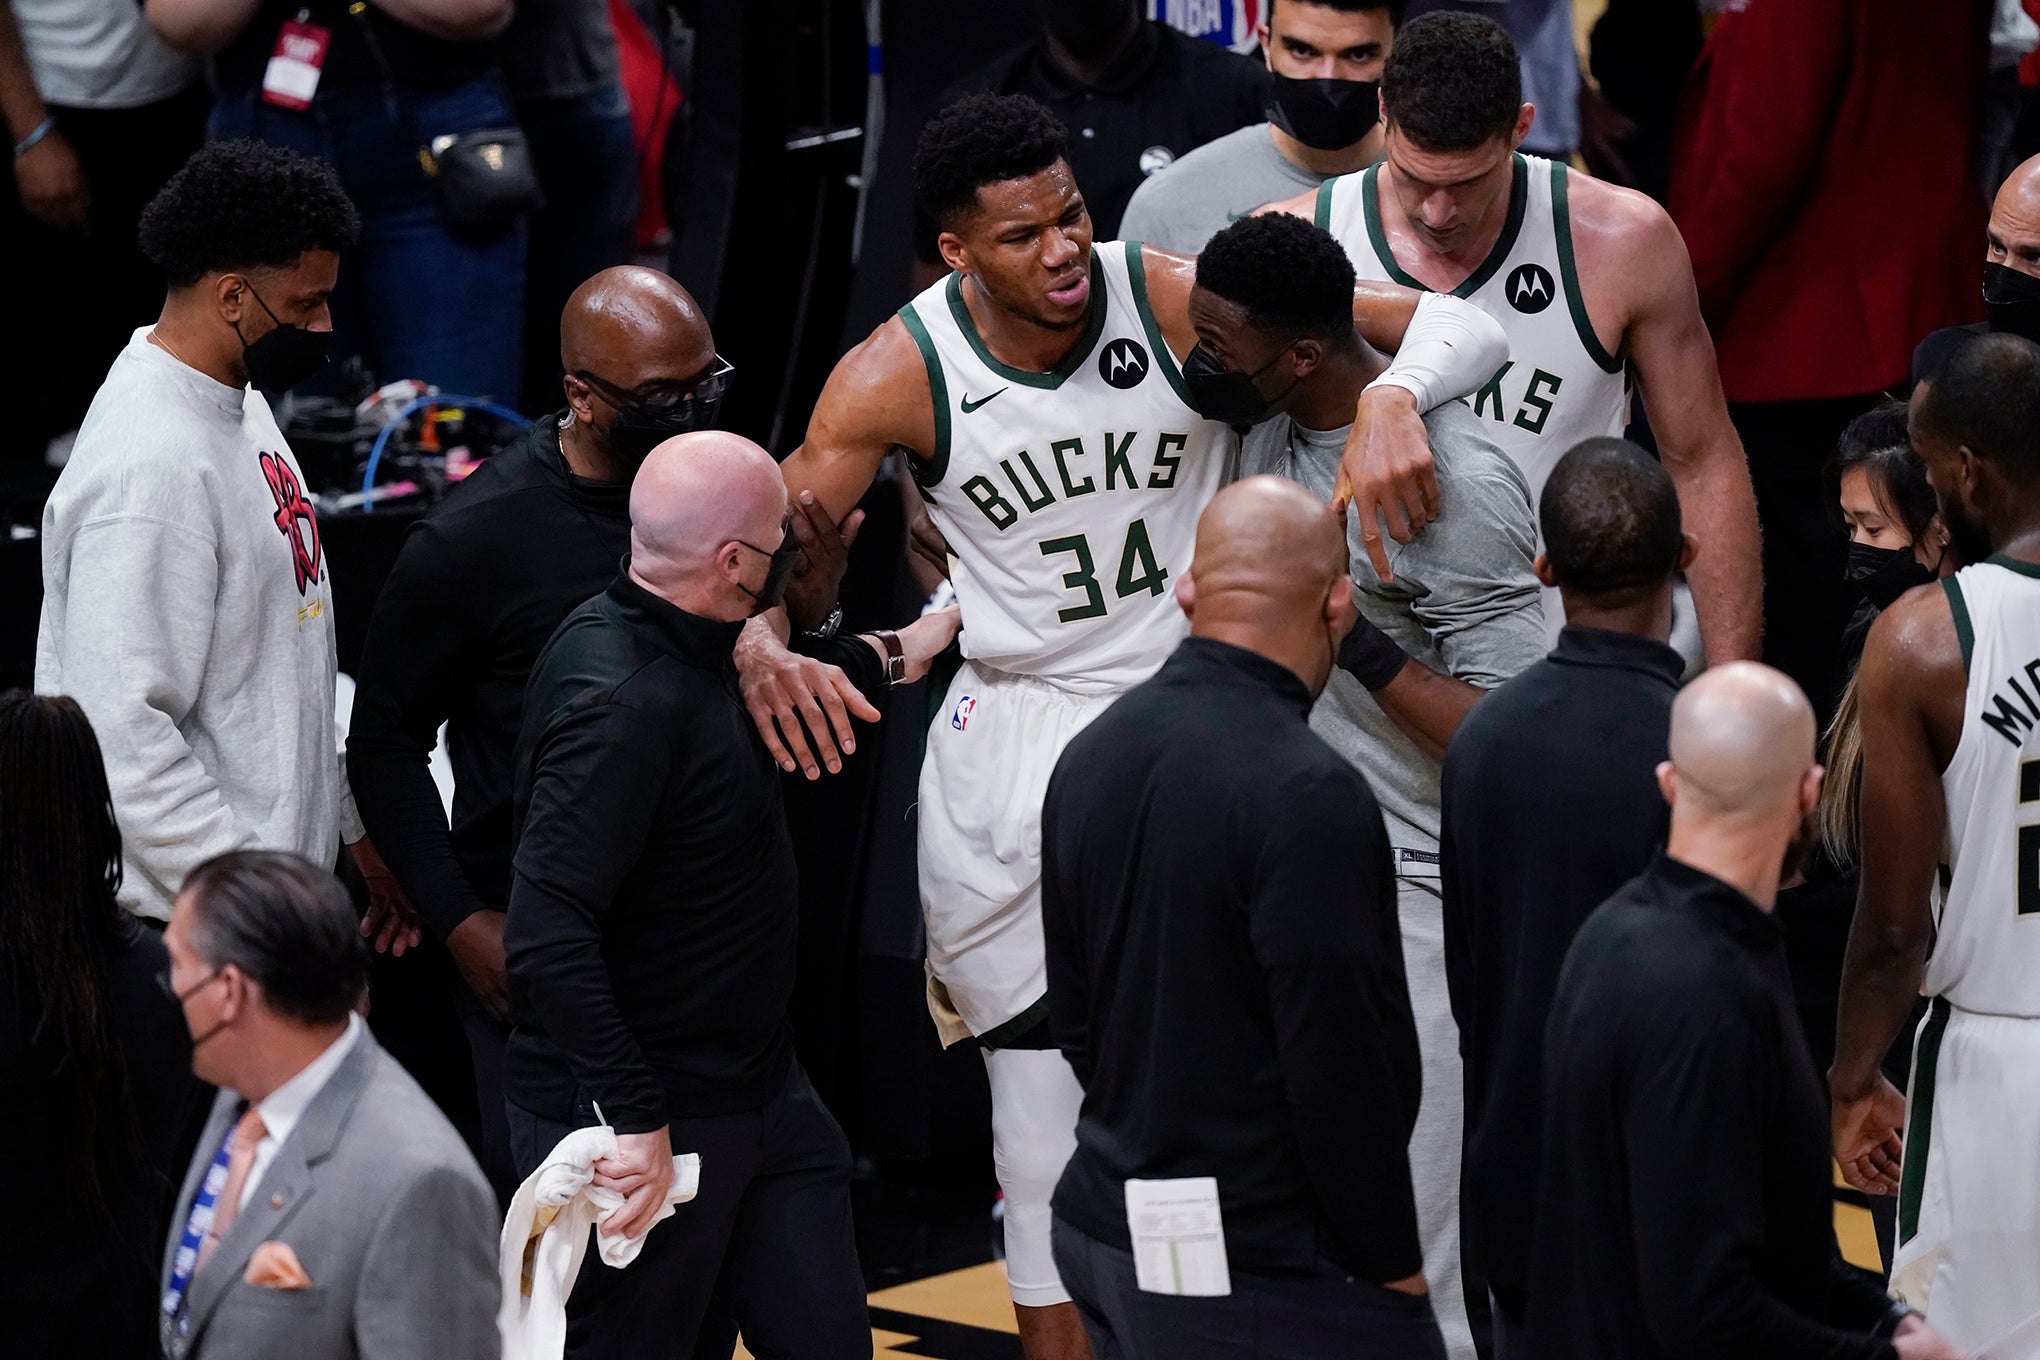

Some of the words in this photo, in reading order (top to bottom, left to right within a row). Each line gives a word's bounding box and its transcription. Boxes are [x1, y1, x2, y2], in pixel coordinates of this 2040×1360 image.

[959, 431, 1189, 532] BUCKS
[1038, 518, 1169, 624] 34
[1403, 852, 1413, 860] XL
